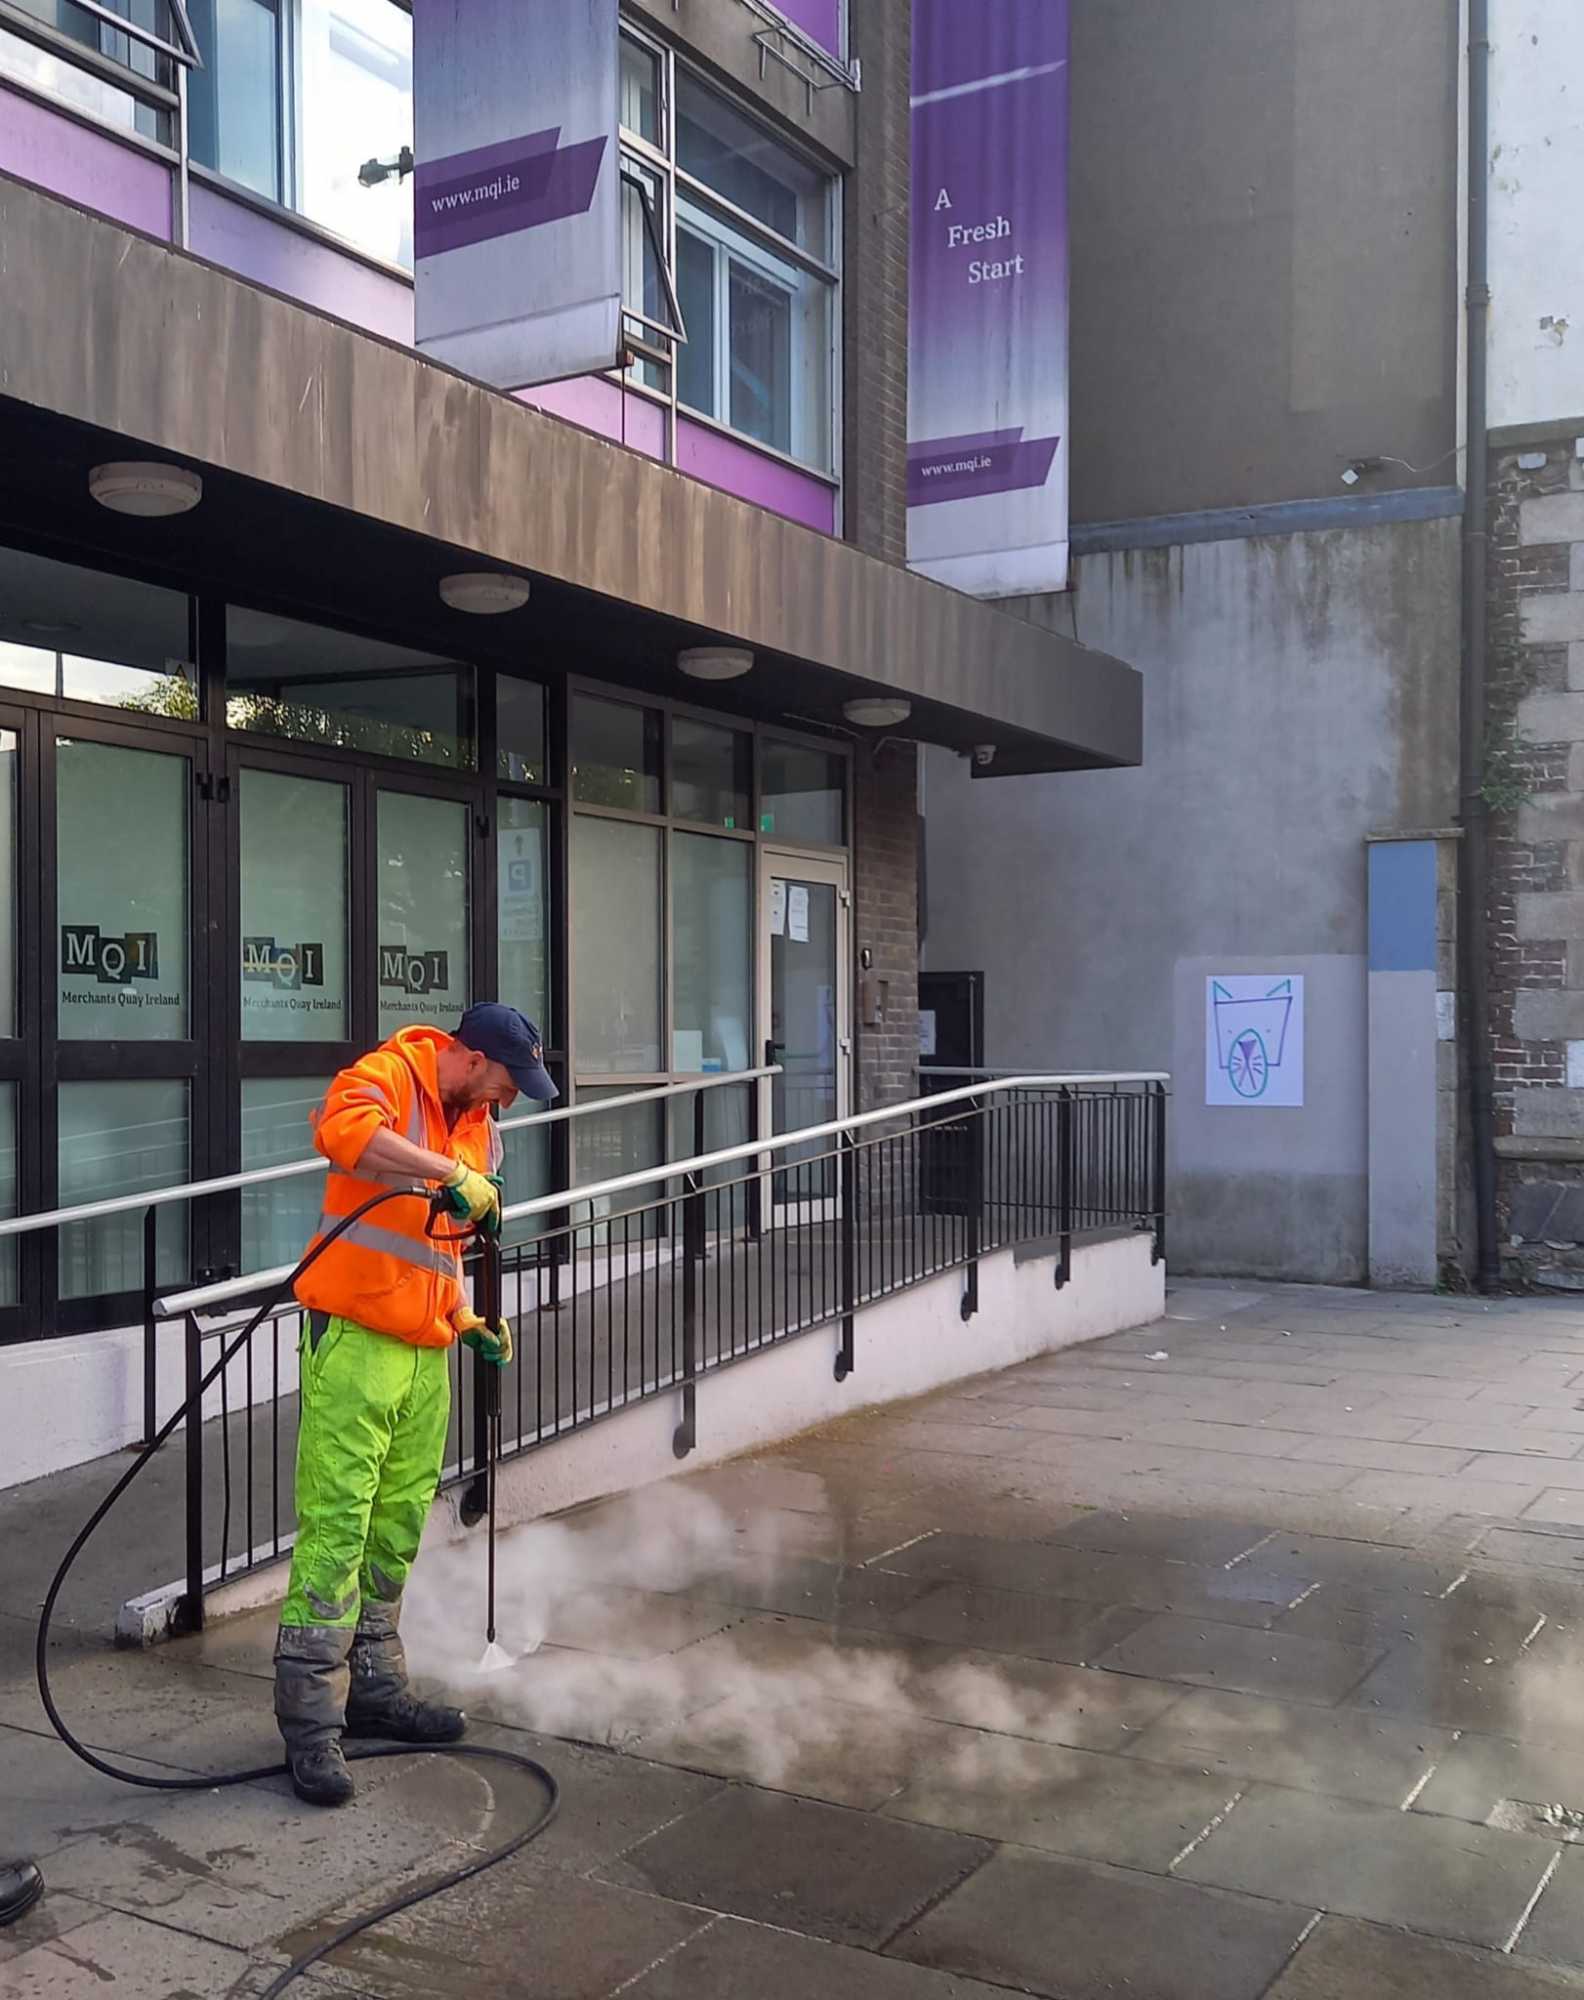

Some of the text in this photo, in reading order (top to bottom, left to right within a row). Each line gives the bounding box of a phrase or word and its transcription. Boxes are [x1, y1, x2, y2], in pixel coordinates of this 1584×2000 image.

[431, 174, 520, 213] www.mqi.ie
[934, 188, 953, 211] A
[947, 216, 1011, 248] Fresh
[968, 254, 1025, 284] Start
[921, 455, 992, 477] www.mqi.ie
[65, 932, 147, 980] MQI
[246, 943, 314, 987] MQI
[382, 952, 441, 991] MQI
[62, 991, 180, 1007] Merchants Quay Ireland
[313, 999, 342, 1009] Ireland
